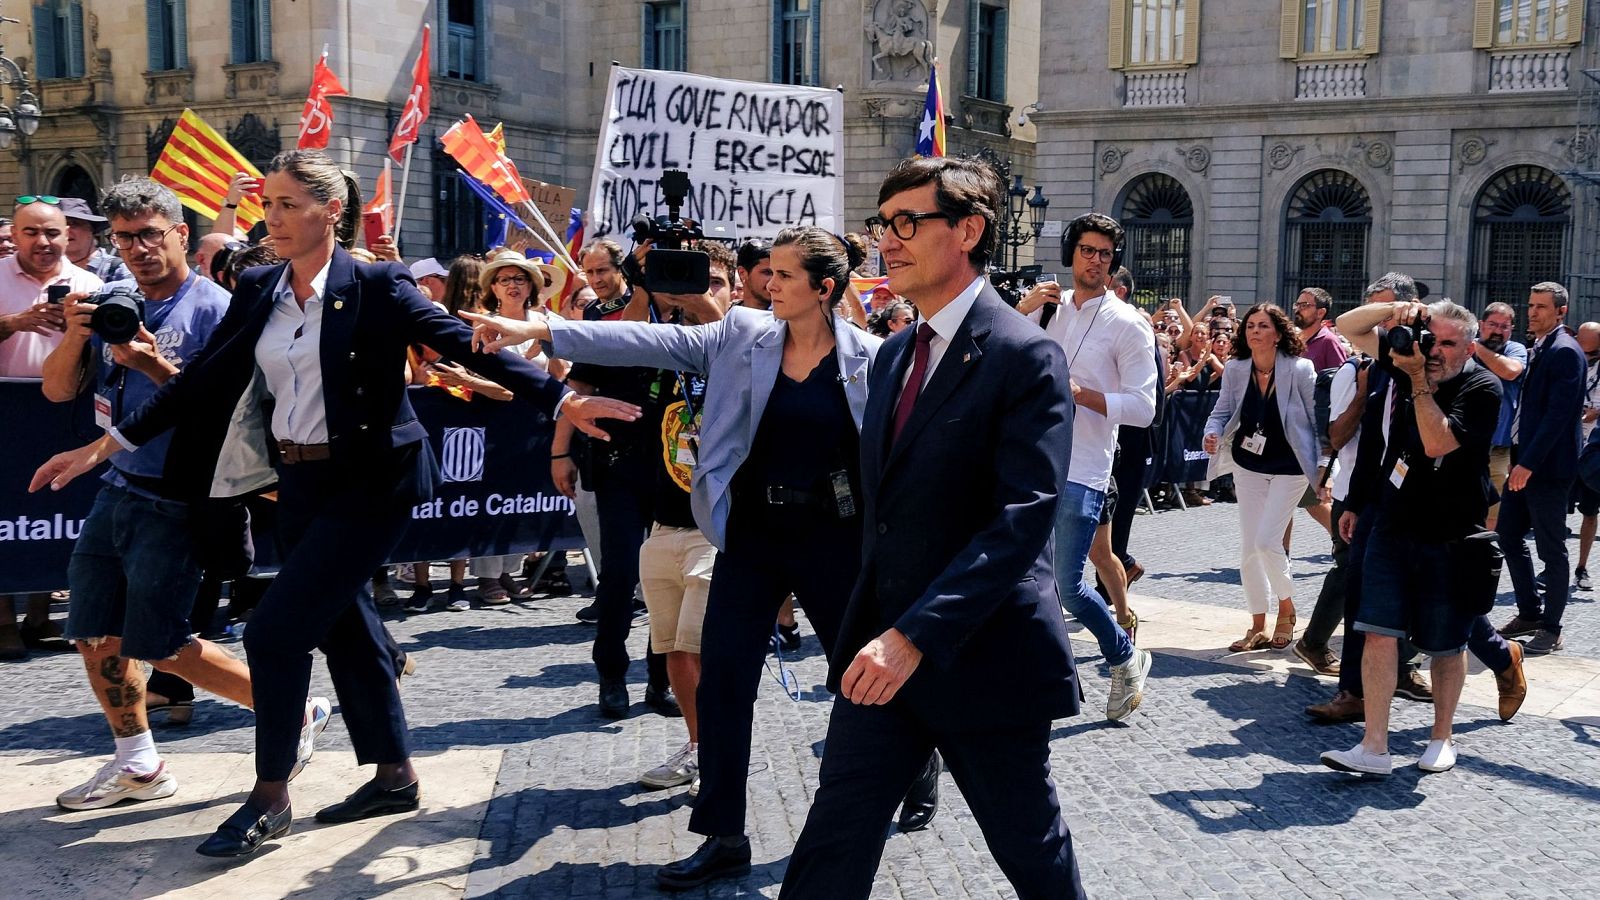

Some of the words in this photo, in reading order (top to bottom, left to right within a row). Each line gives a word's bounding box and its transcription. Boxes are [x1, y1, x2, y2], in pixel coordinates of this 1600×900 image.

[666, 84, 831, 138] GOVERNADOR
[714, 139, 836, 177] ERC=PSOE
[592, 178, 817, 238] INDEPNDÈNCIA
[450, 495, 479, 517] de
